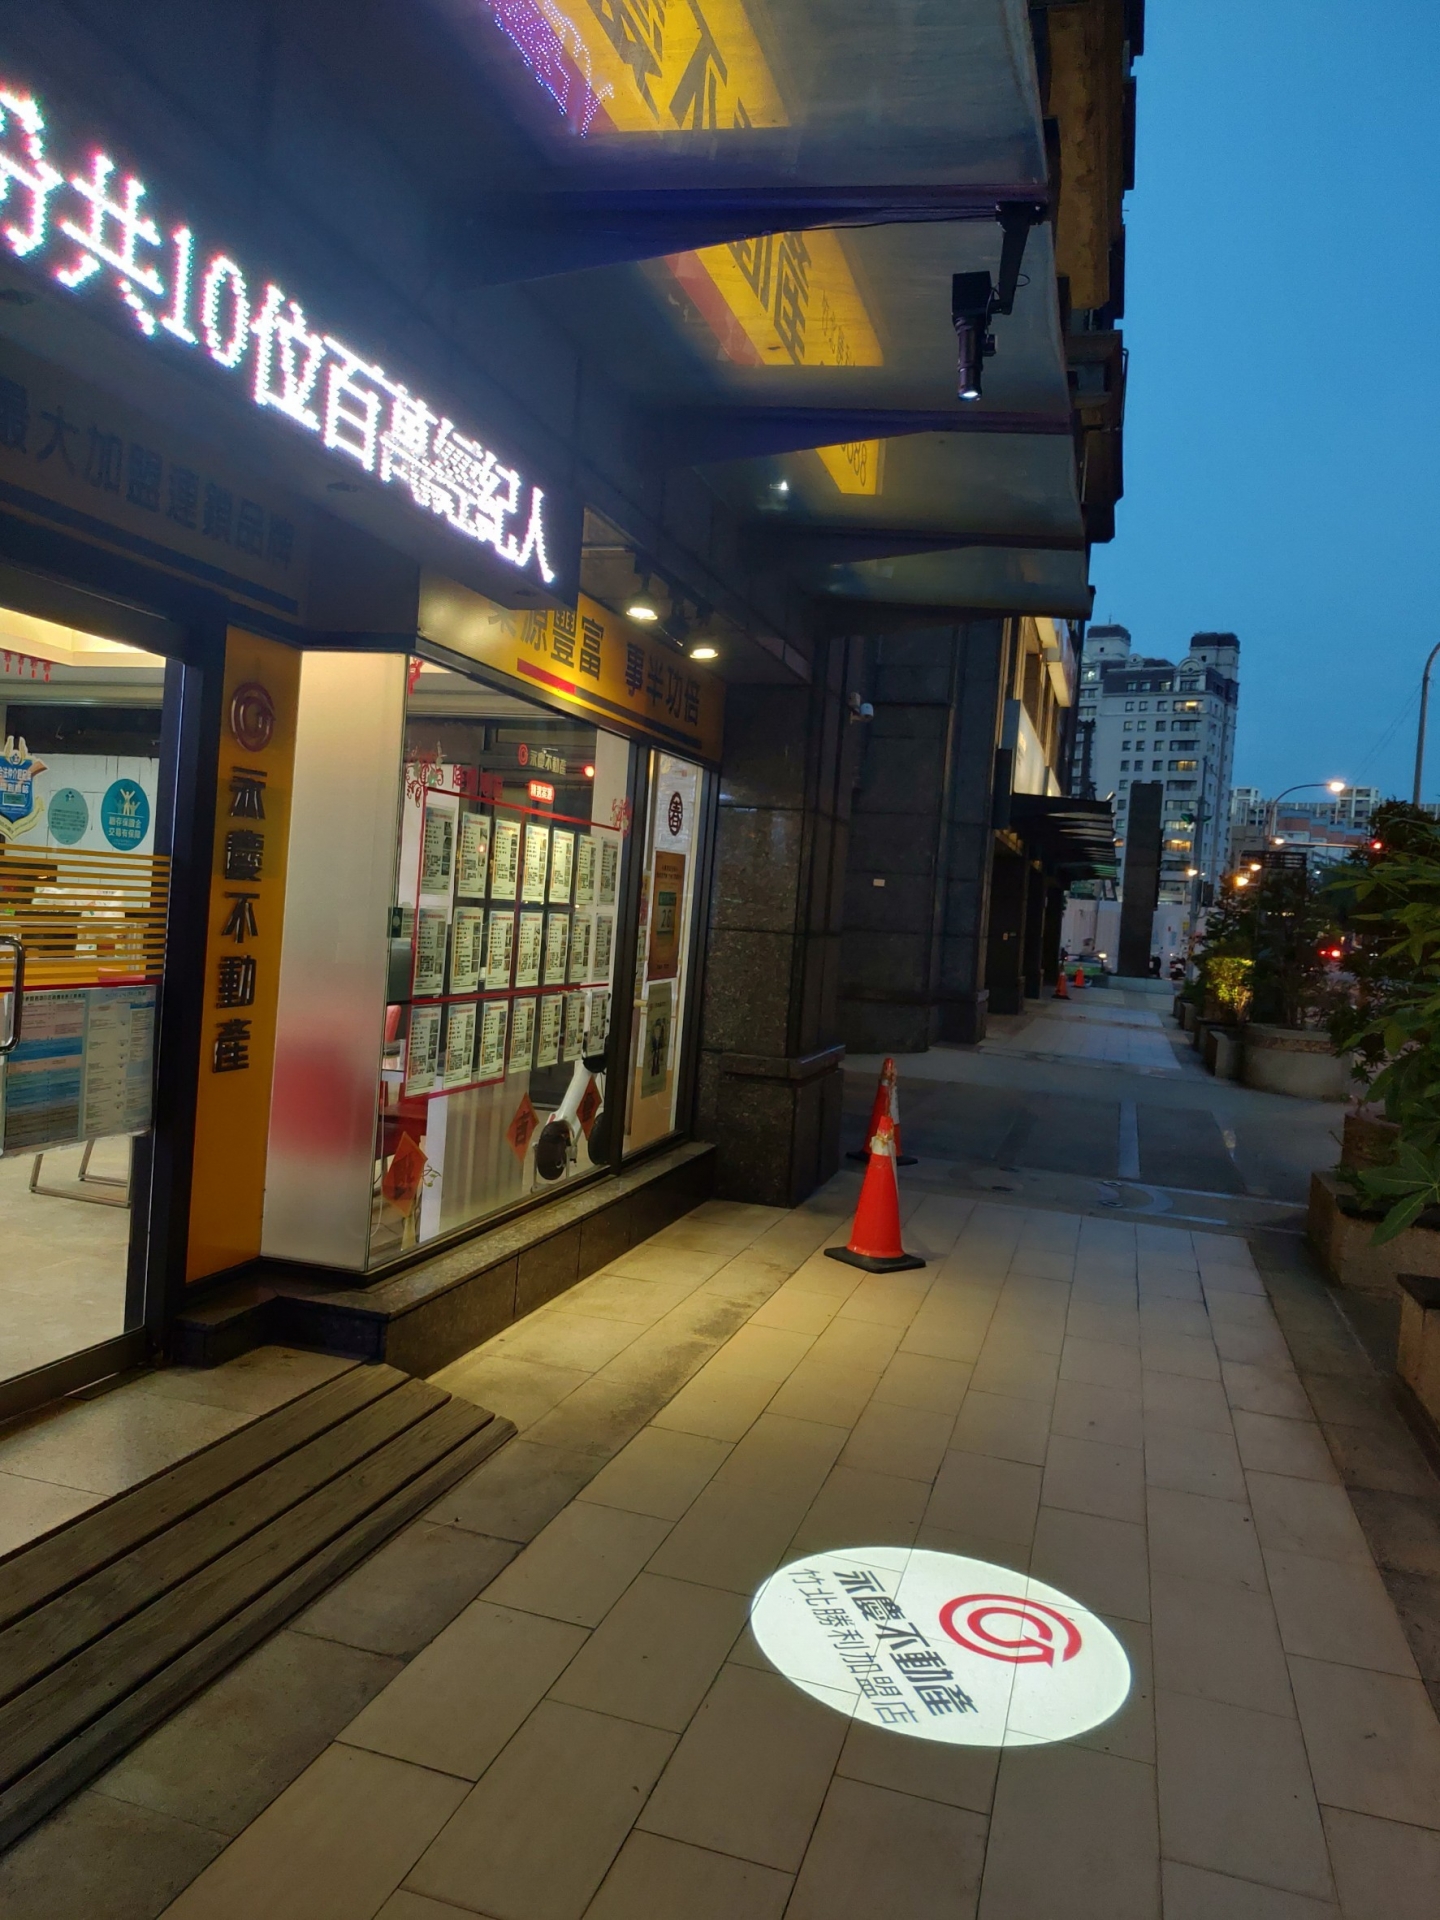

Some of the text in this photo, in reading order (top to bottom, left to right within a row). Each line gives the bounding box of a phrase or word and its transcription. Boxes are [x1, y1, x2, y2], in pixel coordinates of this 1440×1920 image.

[625, 641, 700, 727] 事半功倍
[212, 766, 267, 1074] 永慶不動產
[787, 1568, 920, 1724] 竹北勝利加盟店
[833, 1570, 979, 1717] 永慶不動產
